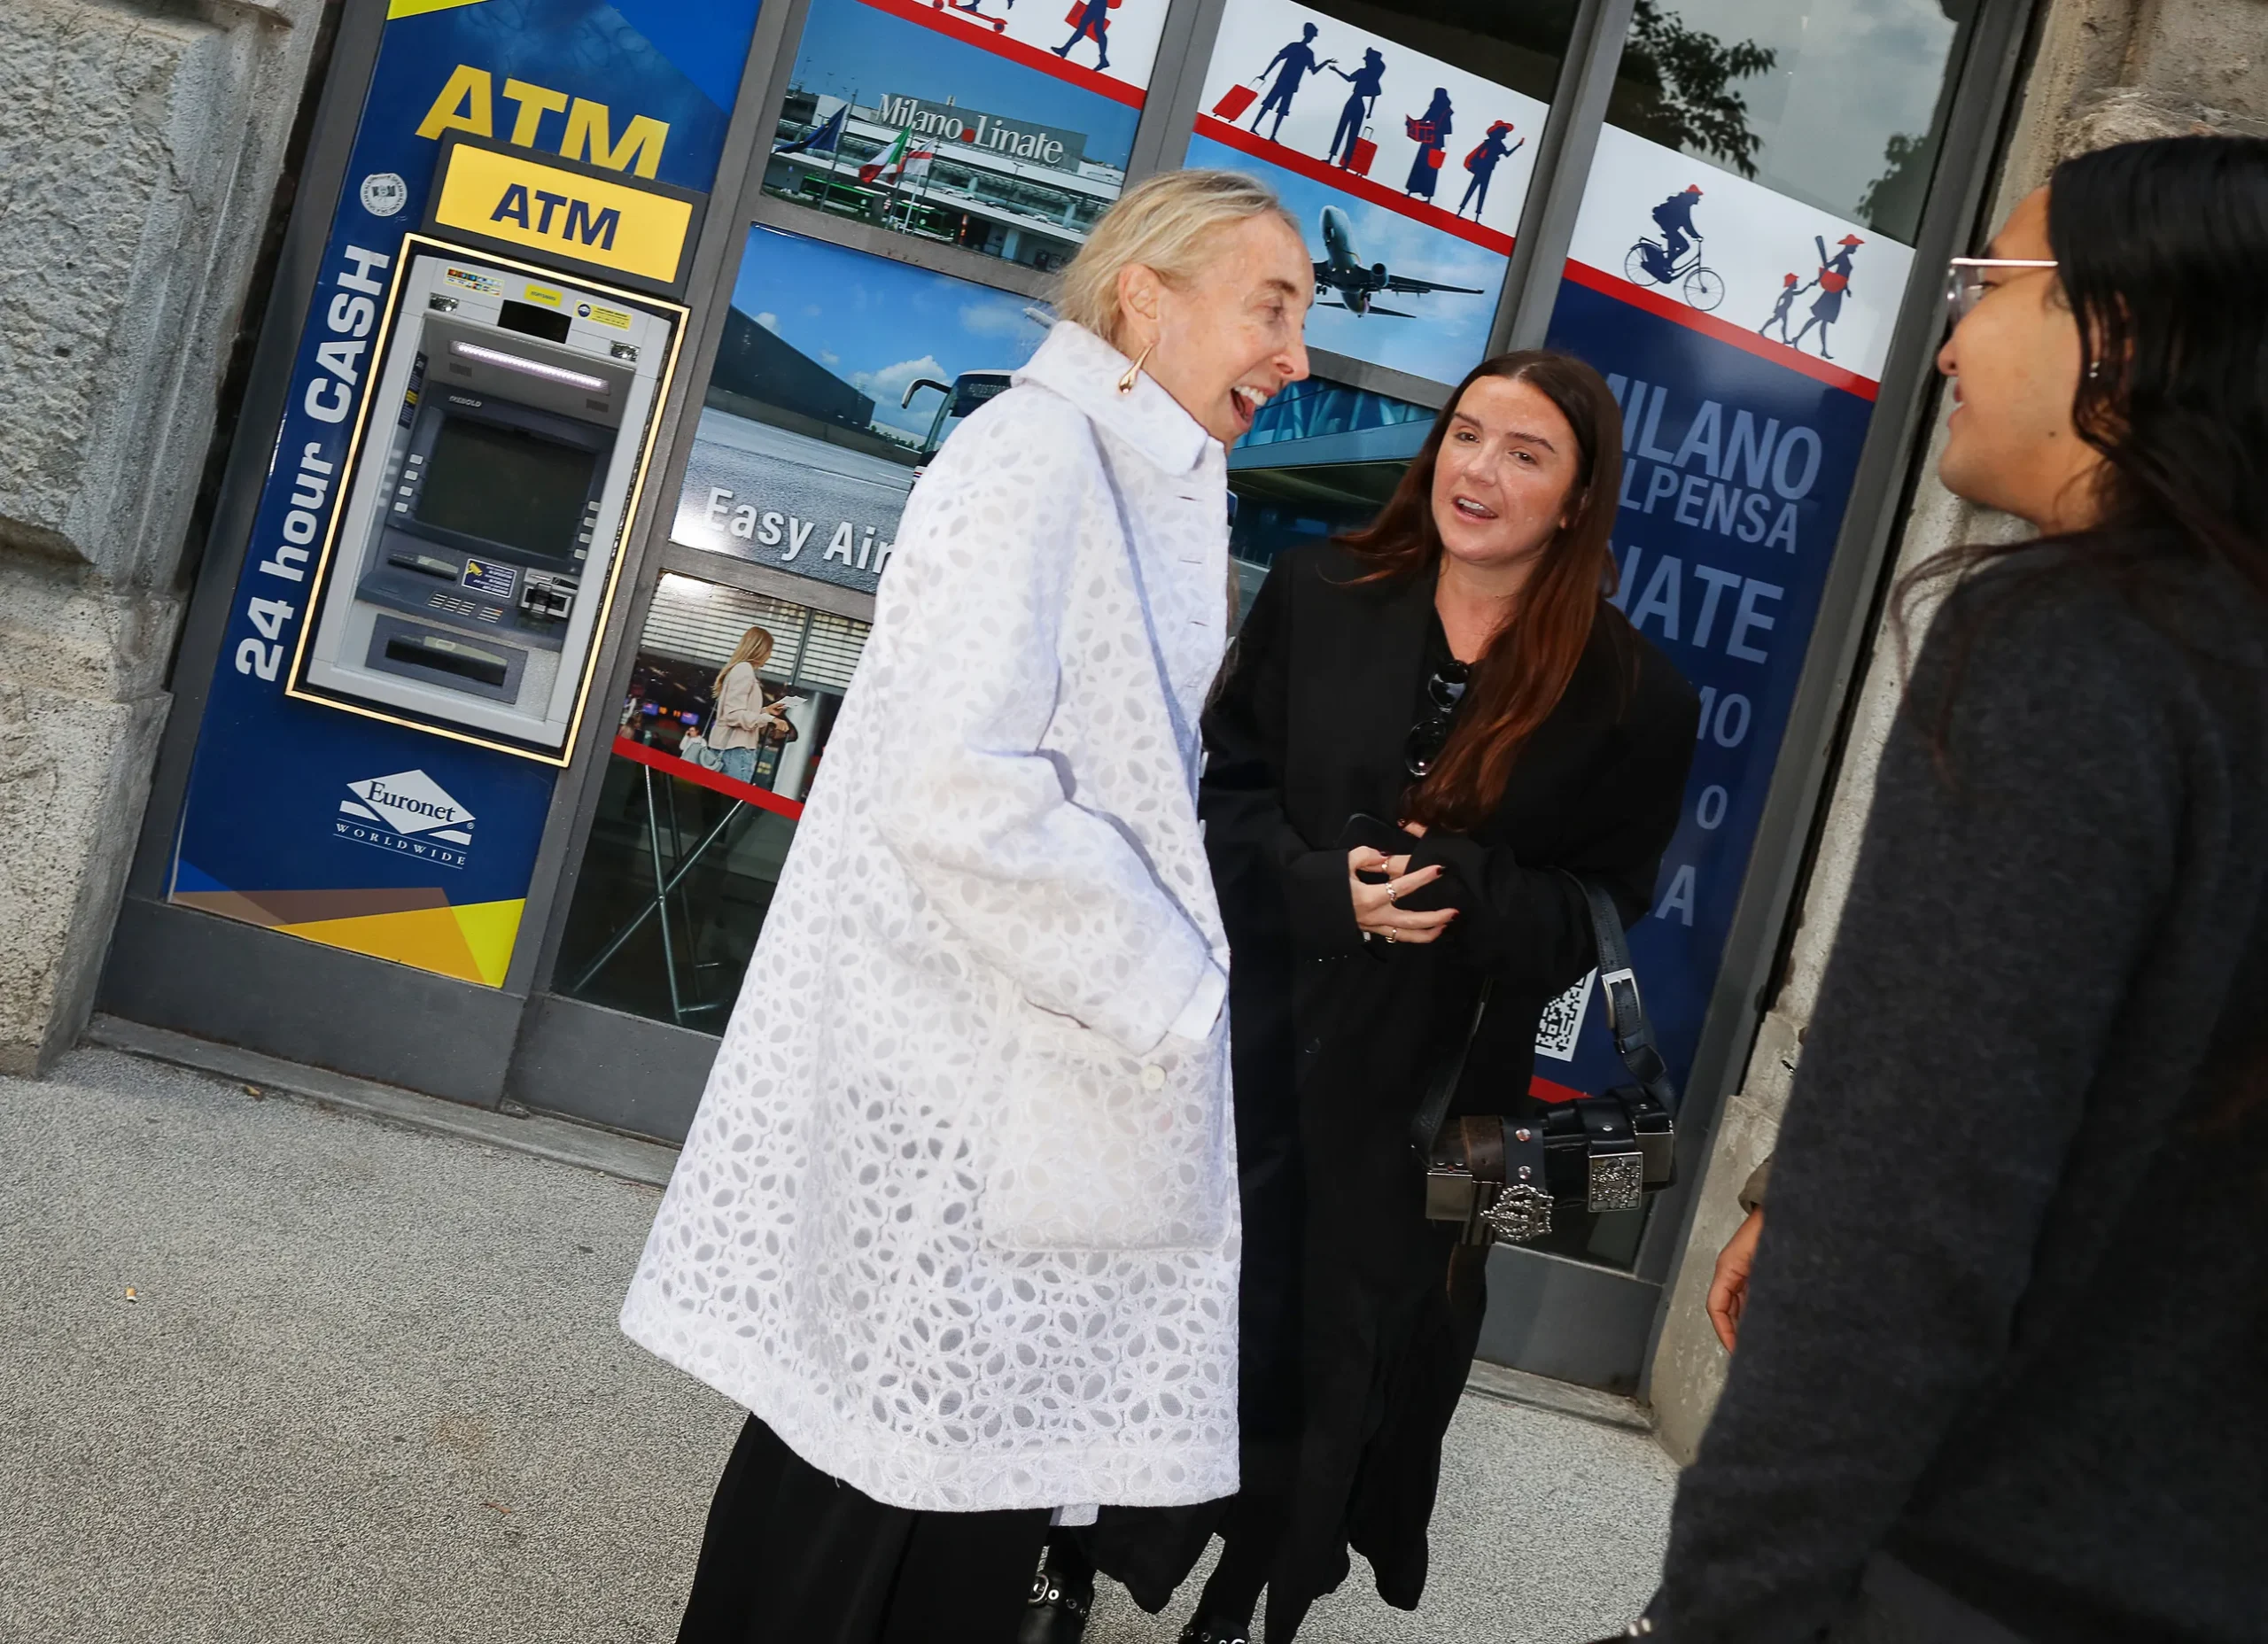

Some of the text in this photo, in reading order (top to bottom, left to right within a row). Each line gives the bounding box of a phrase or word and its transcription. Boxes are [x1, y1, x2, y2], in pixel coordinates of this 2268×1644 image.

[416, 64, 671, 180] ATM
[875, 93, 1064, 165] Milano Linate
[490, 182, 622, 252] ATM
[304, 244, 391, 424] CASH
[259, 441, 334, 582] hour
[705, 486, 895, 574] Easy Air
[1619, 458, 1800, 554] LPENSA
[235, 596, 294, 683] 24
[335, 823, 467, 865] WORLDWIDE
[364, 779, 457, 823] Euronet
